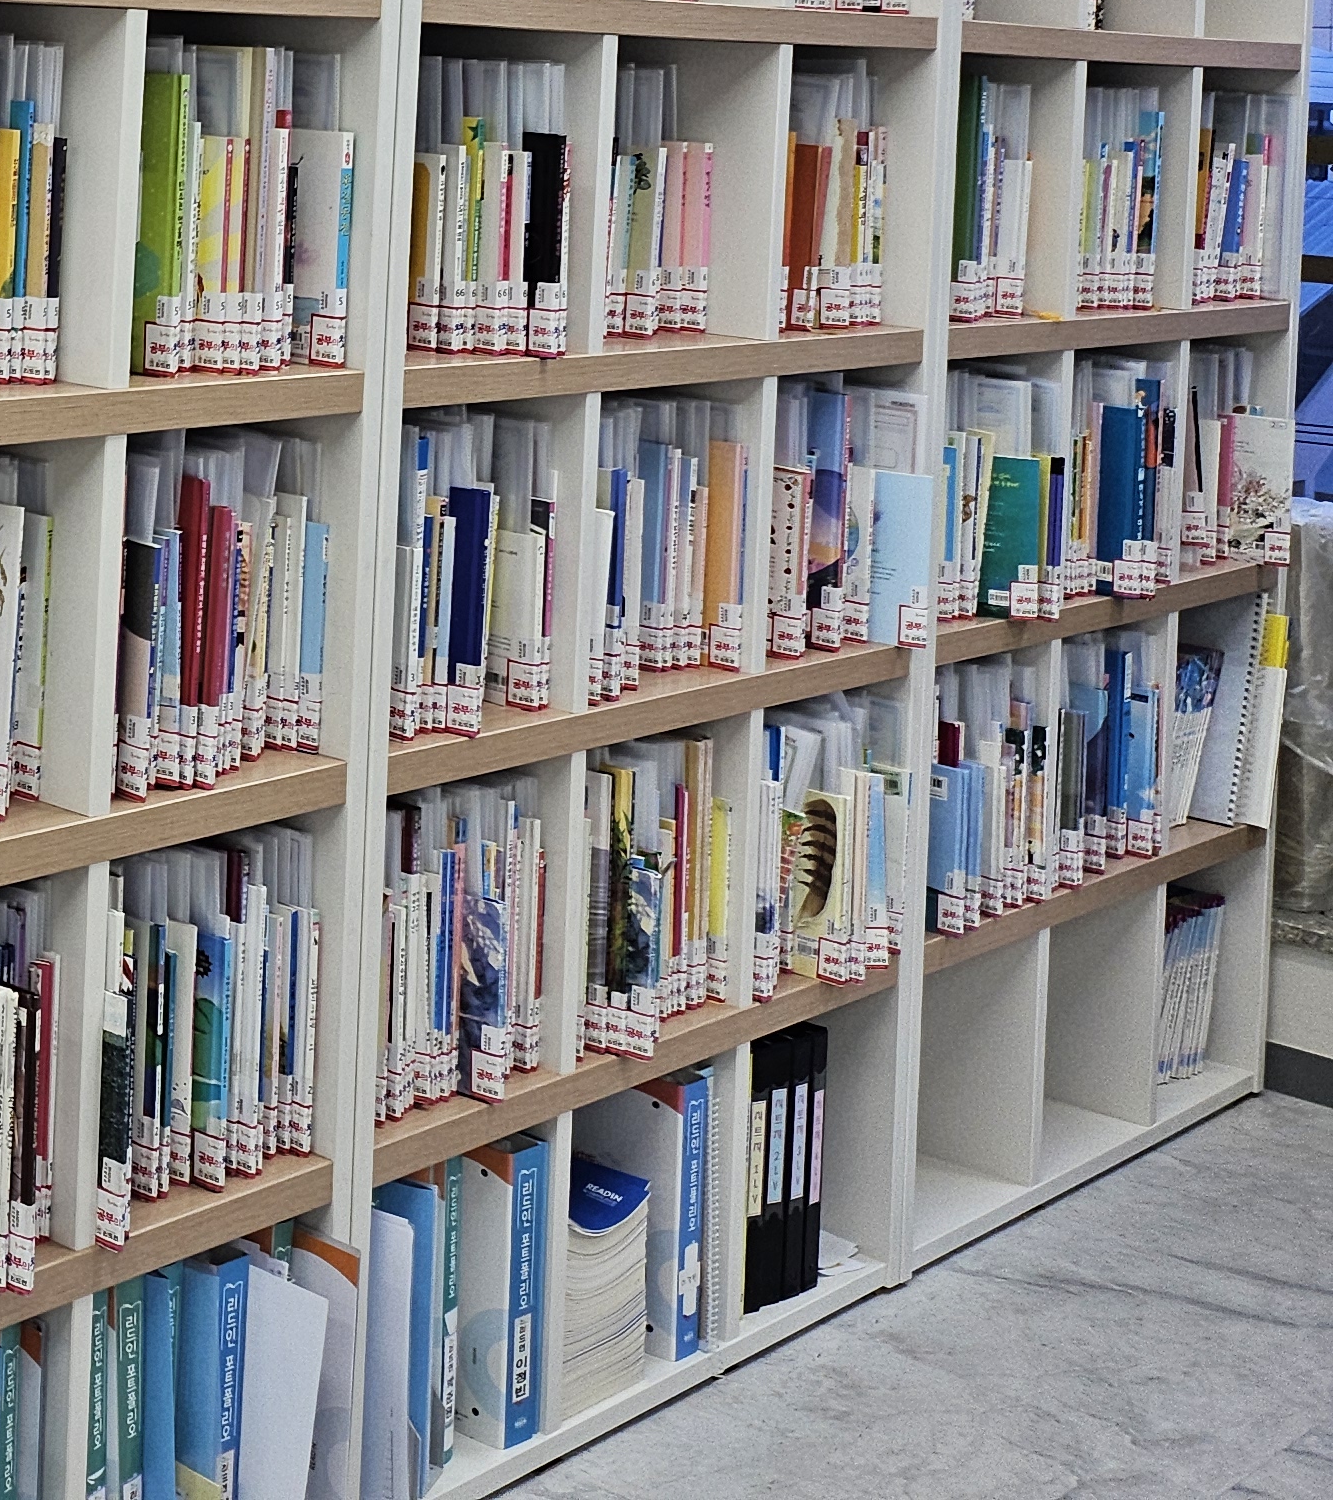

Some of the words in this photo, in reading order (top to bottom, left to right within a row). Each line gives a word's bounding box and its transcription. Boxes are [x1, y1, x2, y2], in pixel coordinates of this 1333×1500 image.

[690, 1109, 701, 1155] 리드인
[521, 1181, 533, 1228] 리드인
[585, 1182, 623, 1204] READIN
[687, 1158, 699, 1233] 포트폴리오
[519, 1233, 531, 1311] 포트폴리오
[123, 1315, 138, 1360] 리드인
[223, 1295, 238, 1349] 리드인
[126, 1364, 138, 1440] 포트폴리오
[220, 1355, 236, 1442] 포트폴리오
